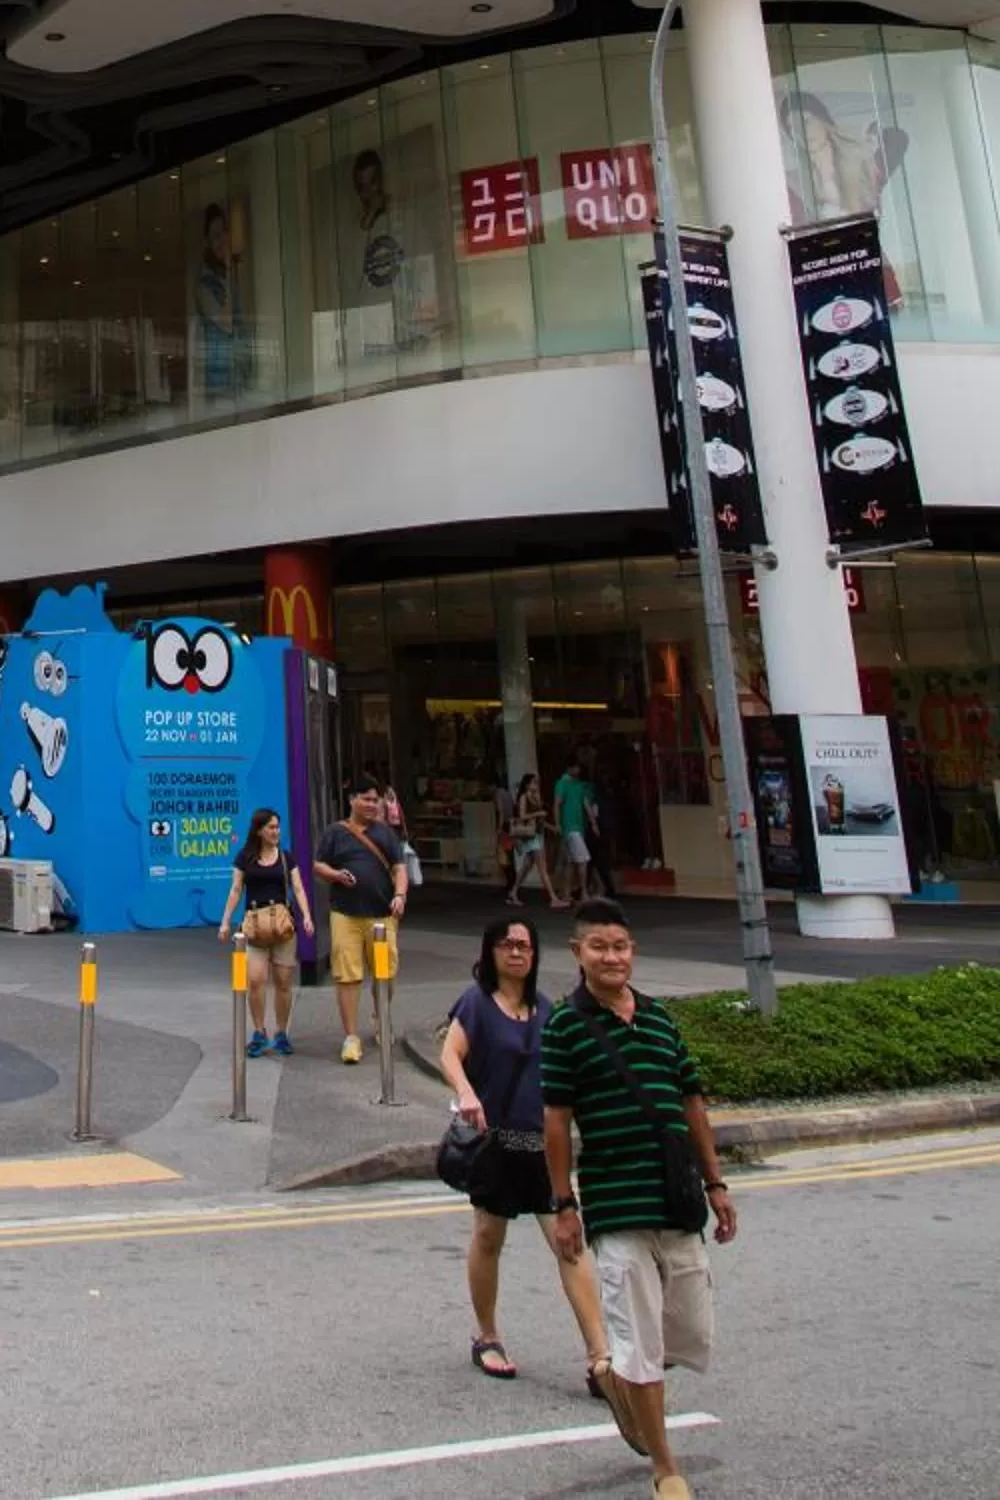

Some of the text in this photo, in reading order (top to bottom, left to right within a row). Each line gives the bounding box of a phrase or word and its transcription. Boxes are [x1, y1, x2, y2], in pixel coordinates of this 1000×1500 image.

[571, 157, 637, 192] UNI
[575, 191, 648, 231] QLO
[145, 710, 237, 727] POP UP STORE
[161, 730, 187, 742] NOV
